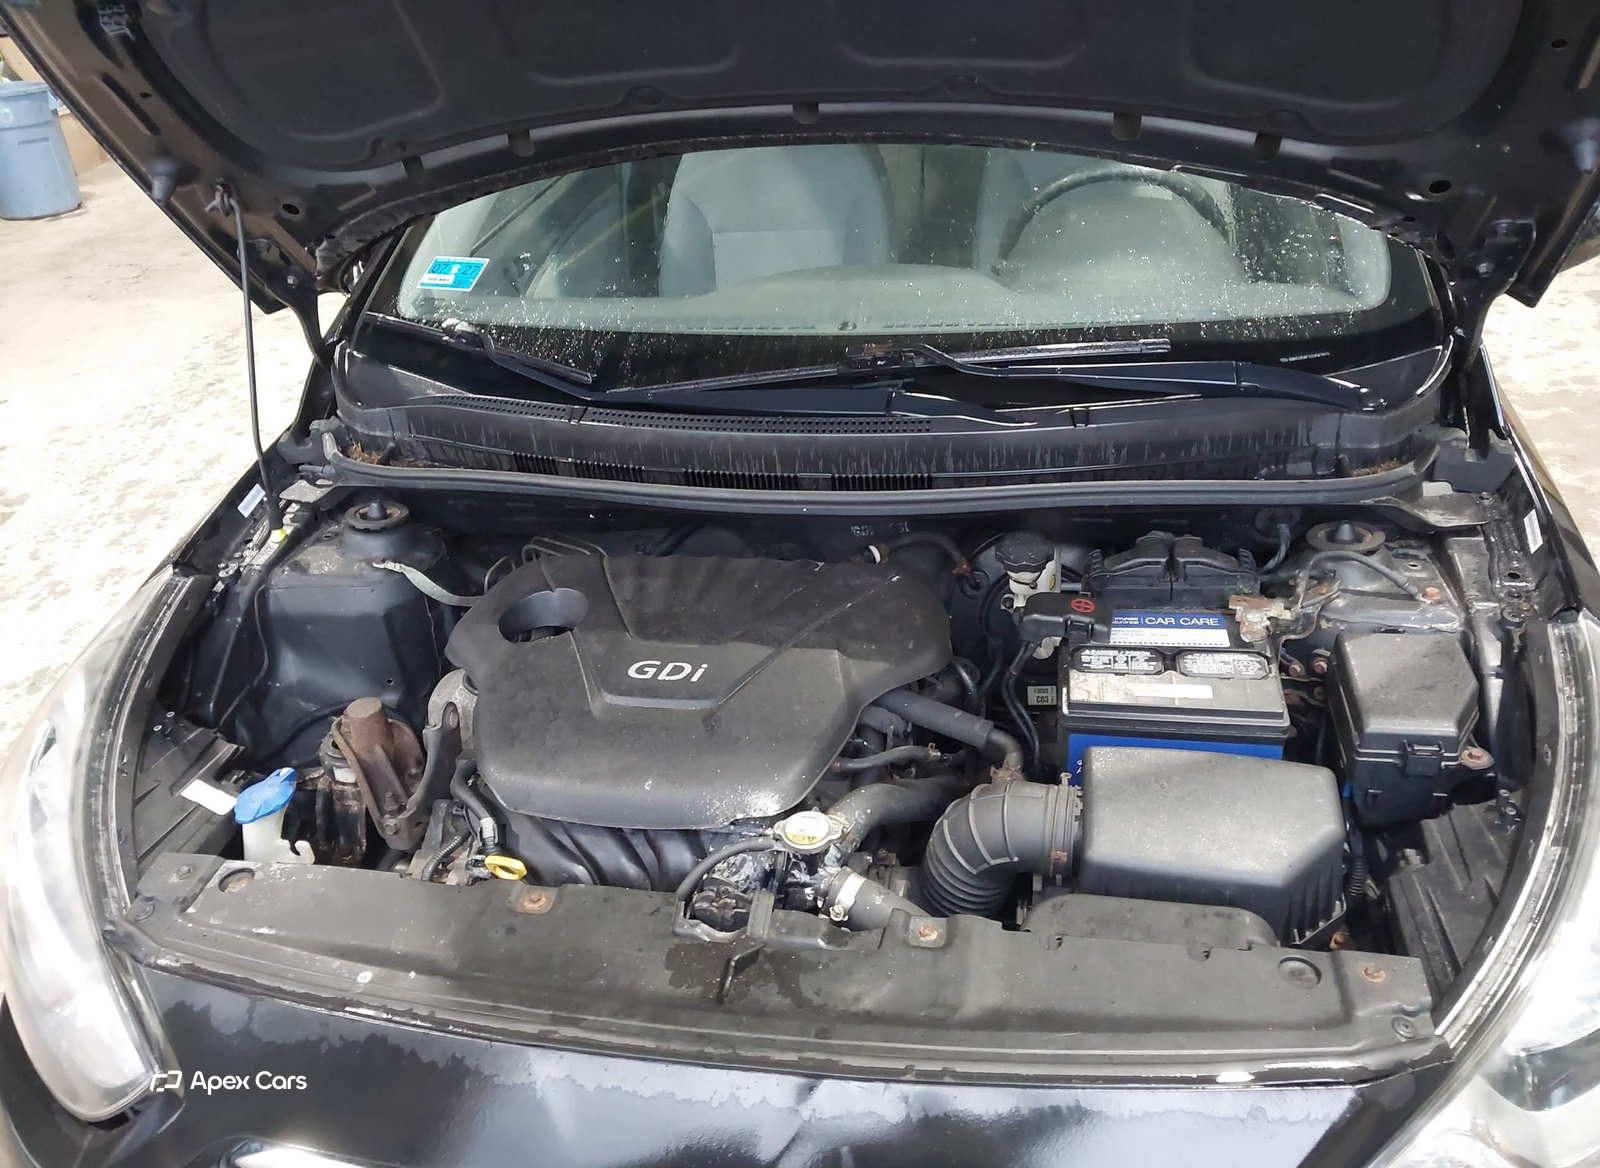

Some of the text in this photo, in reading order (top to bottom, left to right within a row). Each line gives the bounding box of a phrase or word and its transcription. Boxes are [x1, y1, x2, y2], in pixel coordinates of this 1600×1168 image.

[431, 263, 481, 276] 07 27
[1144, 617, 1176, 625] CAR
[1179, 617, 1220, 626] CARE
[627, 660, 709, 682] GDi
